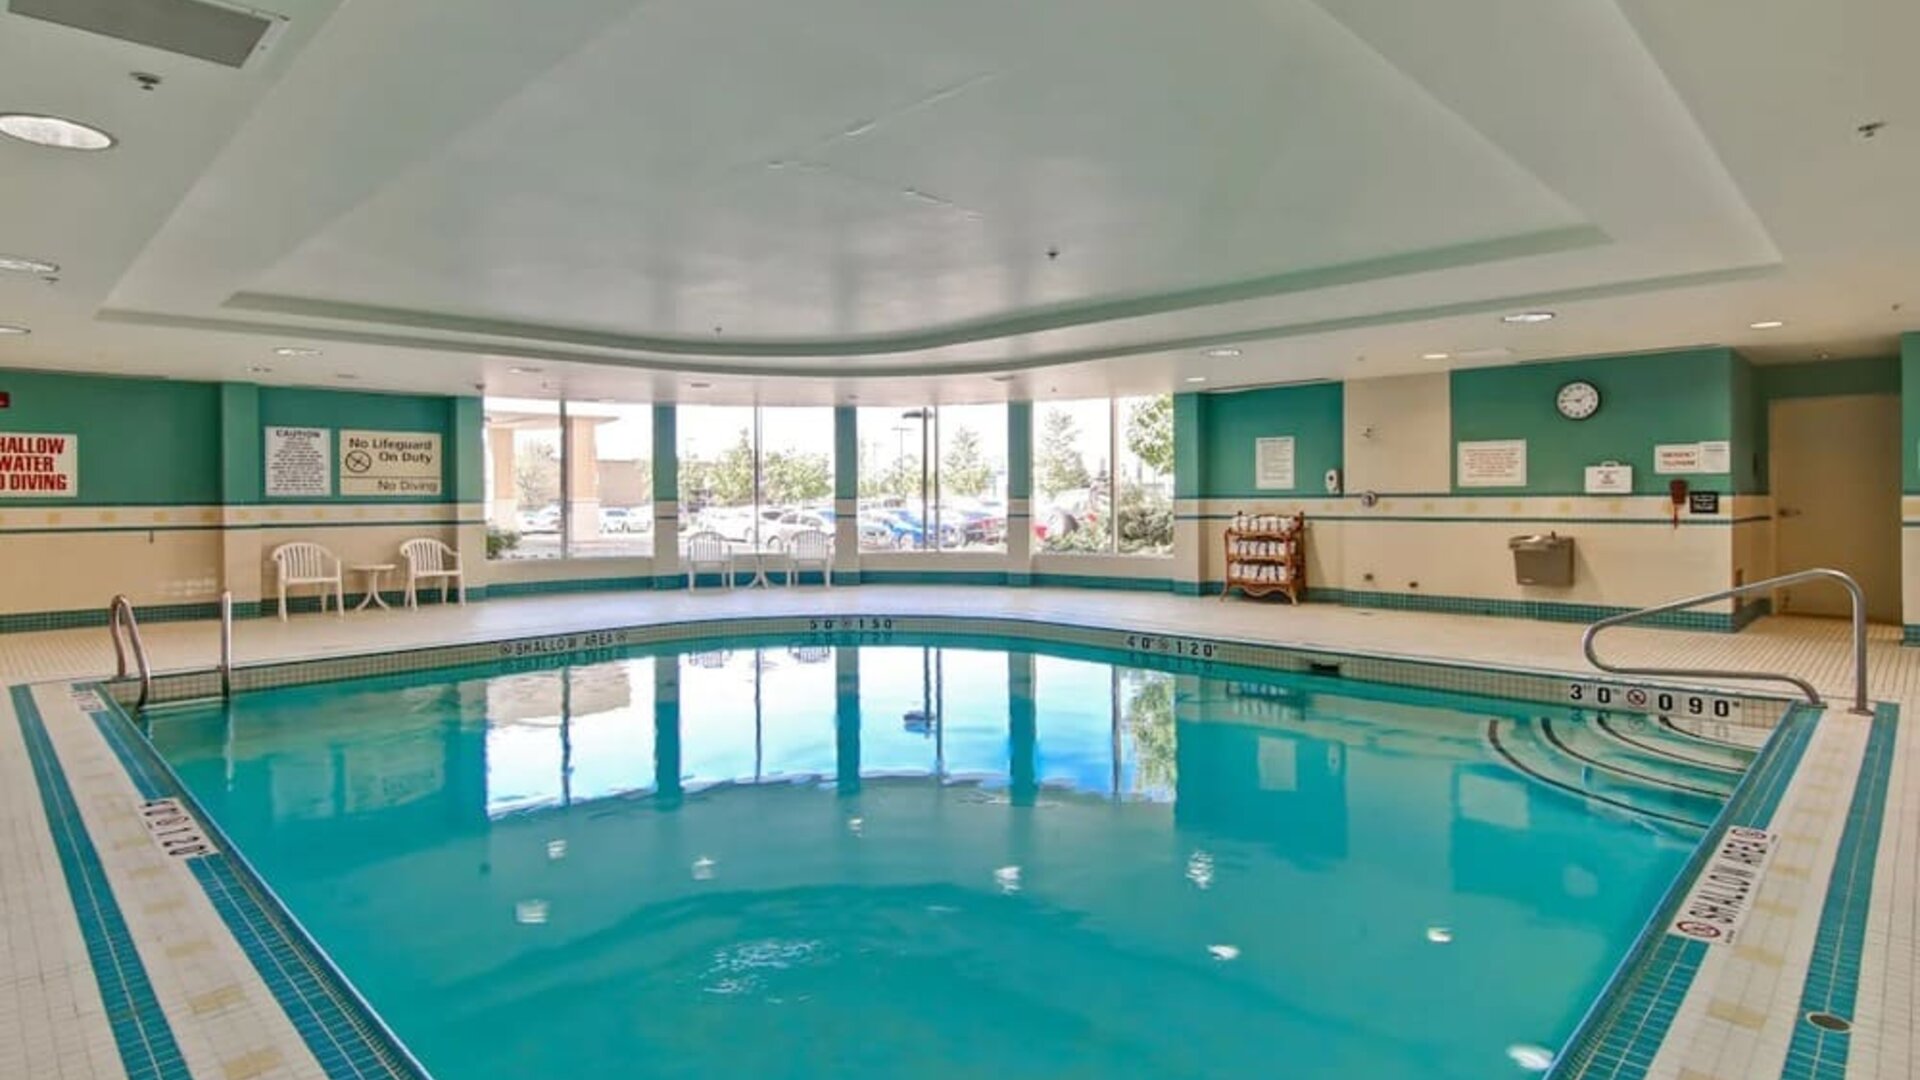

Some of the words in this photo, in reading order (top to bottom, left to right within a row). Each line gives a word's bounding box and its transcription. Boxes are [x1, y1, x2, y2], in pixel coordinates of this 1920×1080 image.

[349, 438, 369, 448] No
[372, 438, 433, 451] Lifeguard
[0, 455, 54, 472] WATER
[379, 452, 398, 461] On
[402, 452, 432, 465] Duty
[10, 474, 67, 490] DIVING
[378, 481, 396, 490] No
[400, 481, 438, 492] Diving
[515, 637, 577, 656] SHALLOW
[584, 632, 613, 647] AREA
[1719, 839, 1769, 868] AREA
[1688, 864, 1756, 924] SHALLOW
